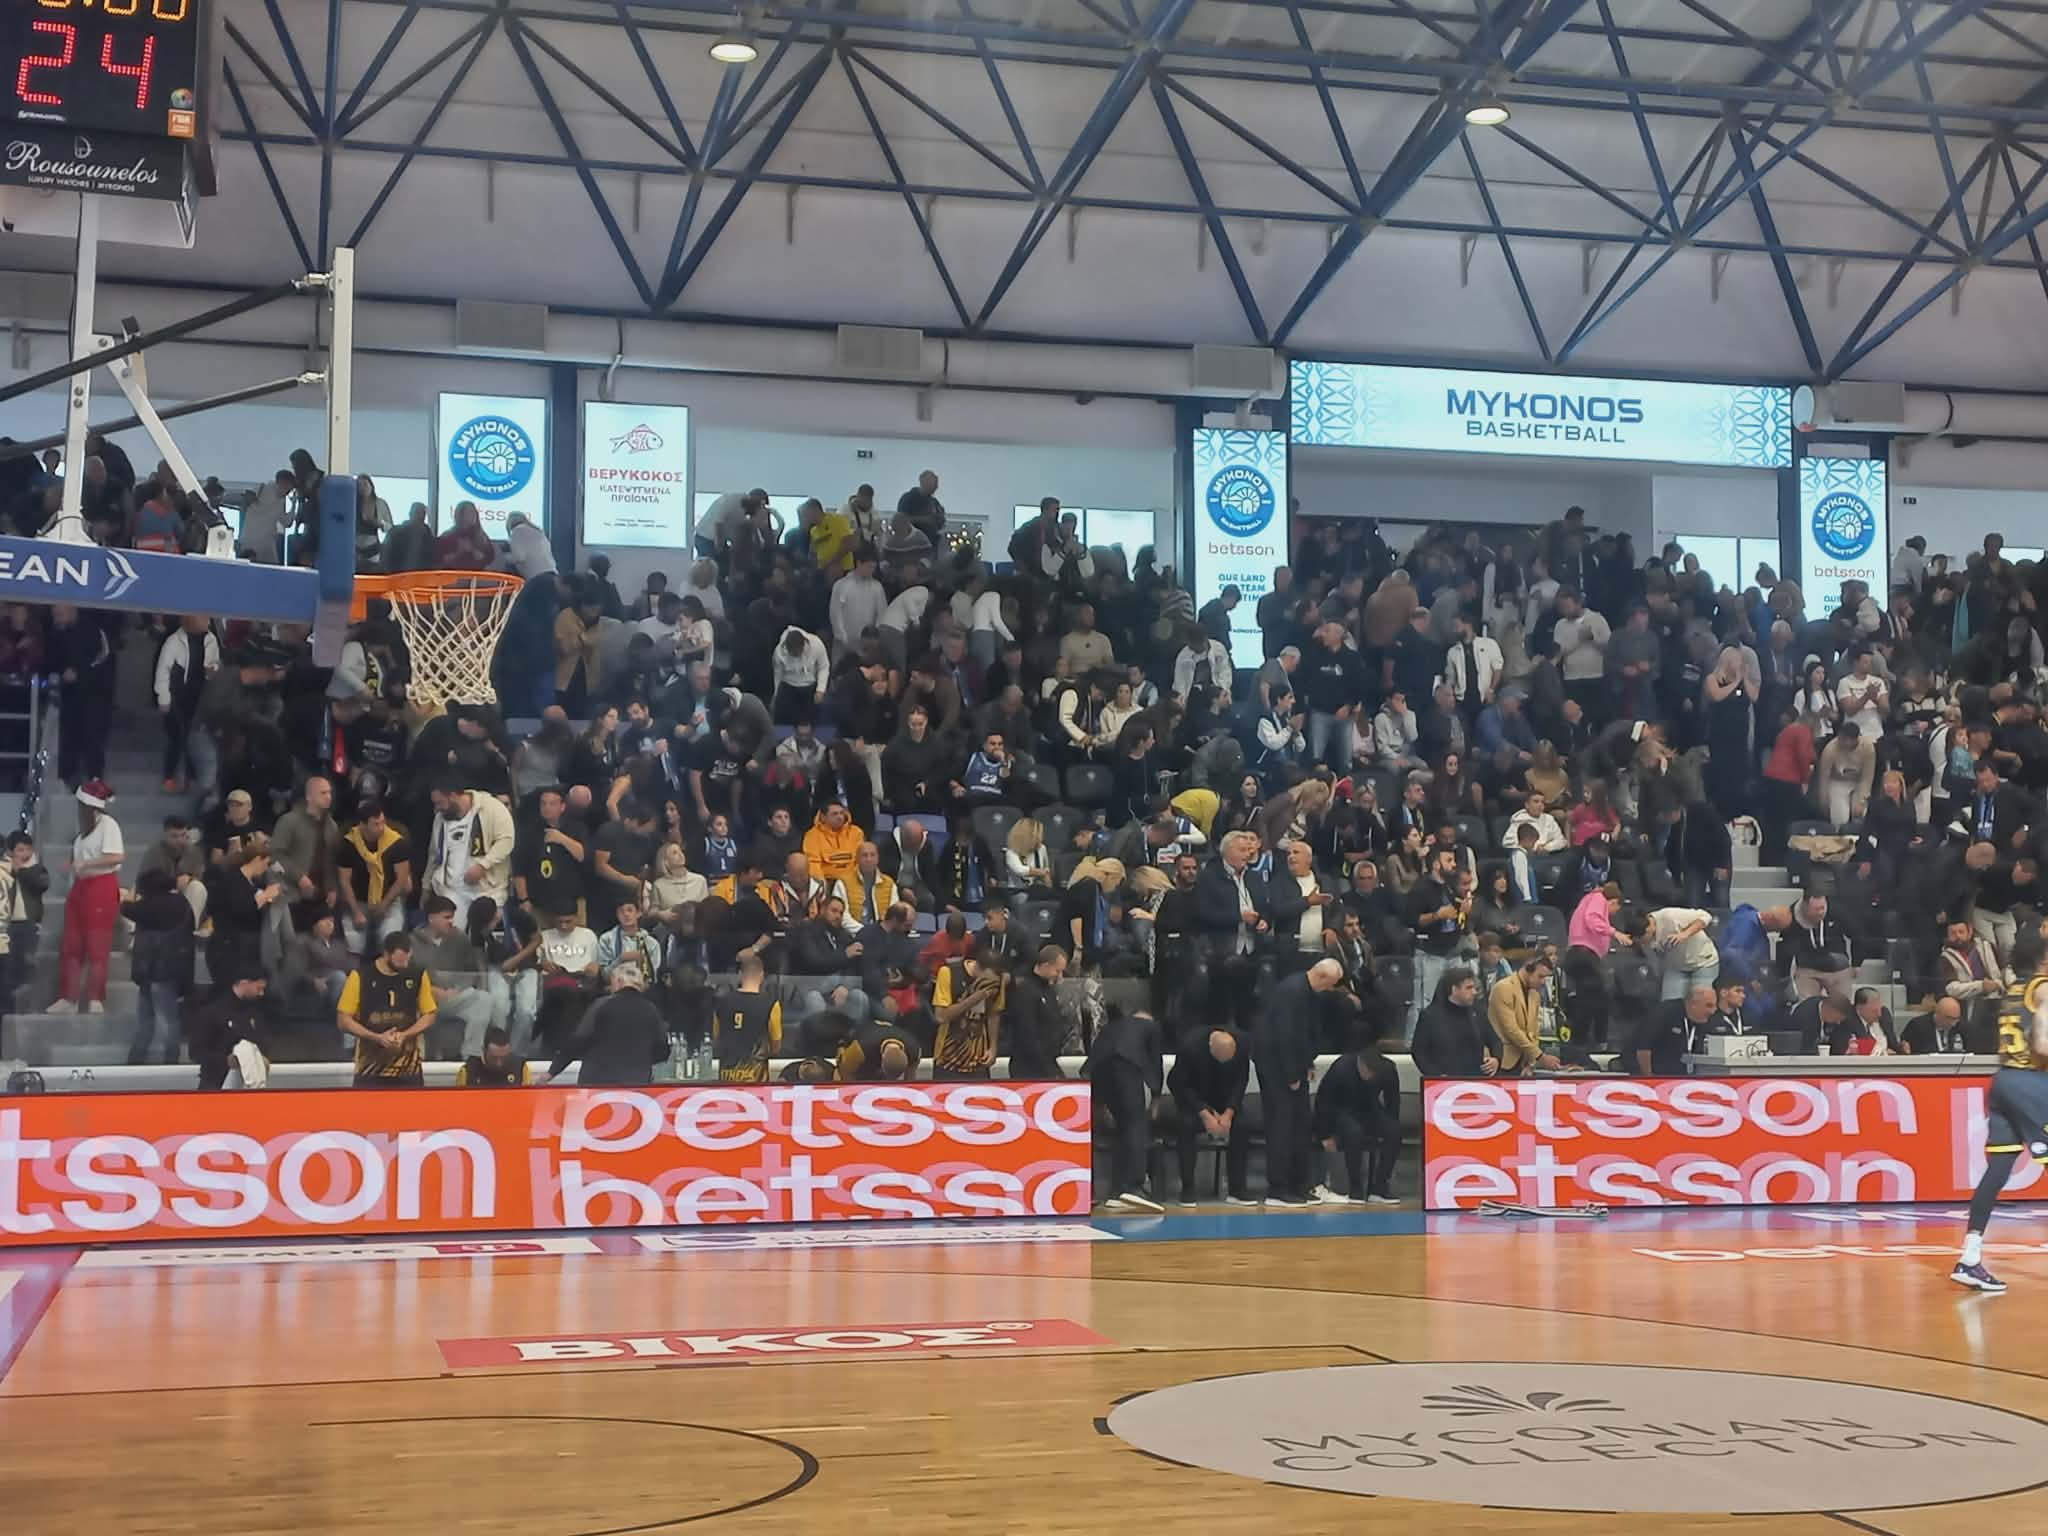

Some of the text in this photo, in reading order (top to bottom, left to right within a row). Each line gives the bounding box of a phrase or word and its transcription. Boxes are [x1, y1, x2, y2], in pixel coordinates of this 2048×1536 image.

[16, 20, 156, 110] 24
[6, 140, 159, 183] Rousounelos
[1447, 389, 1644, 423] MYKONOS
[457, 420, 528, 451] MYKONOS
[1466, 420, 1625, 443] BASKETBALL
[589, 468, 683, 482] ΒΕΡΥΚΟΚΟΣ
[1213, 469, 1268, 495] MYKONOS
[1817, 496, 1869, 520] MYKONOS
[1208, 541, 1274, 556] betsson
[1814, 565, 1875, 579] betsson
[1262, 1417, 1873, 1451] MYCONIAN
[1272, 1430, 2018, 1471] COLLECTION
